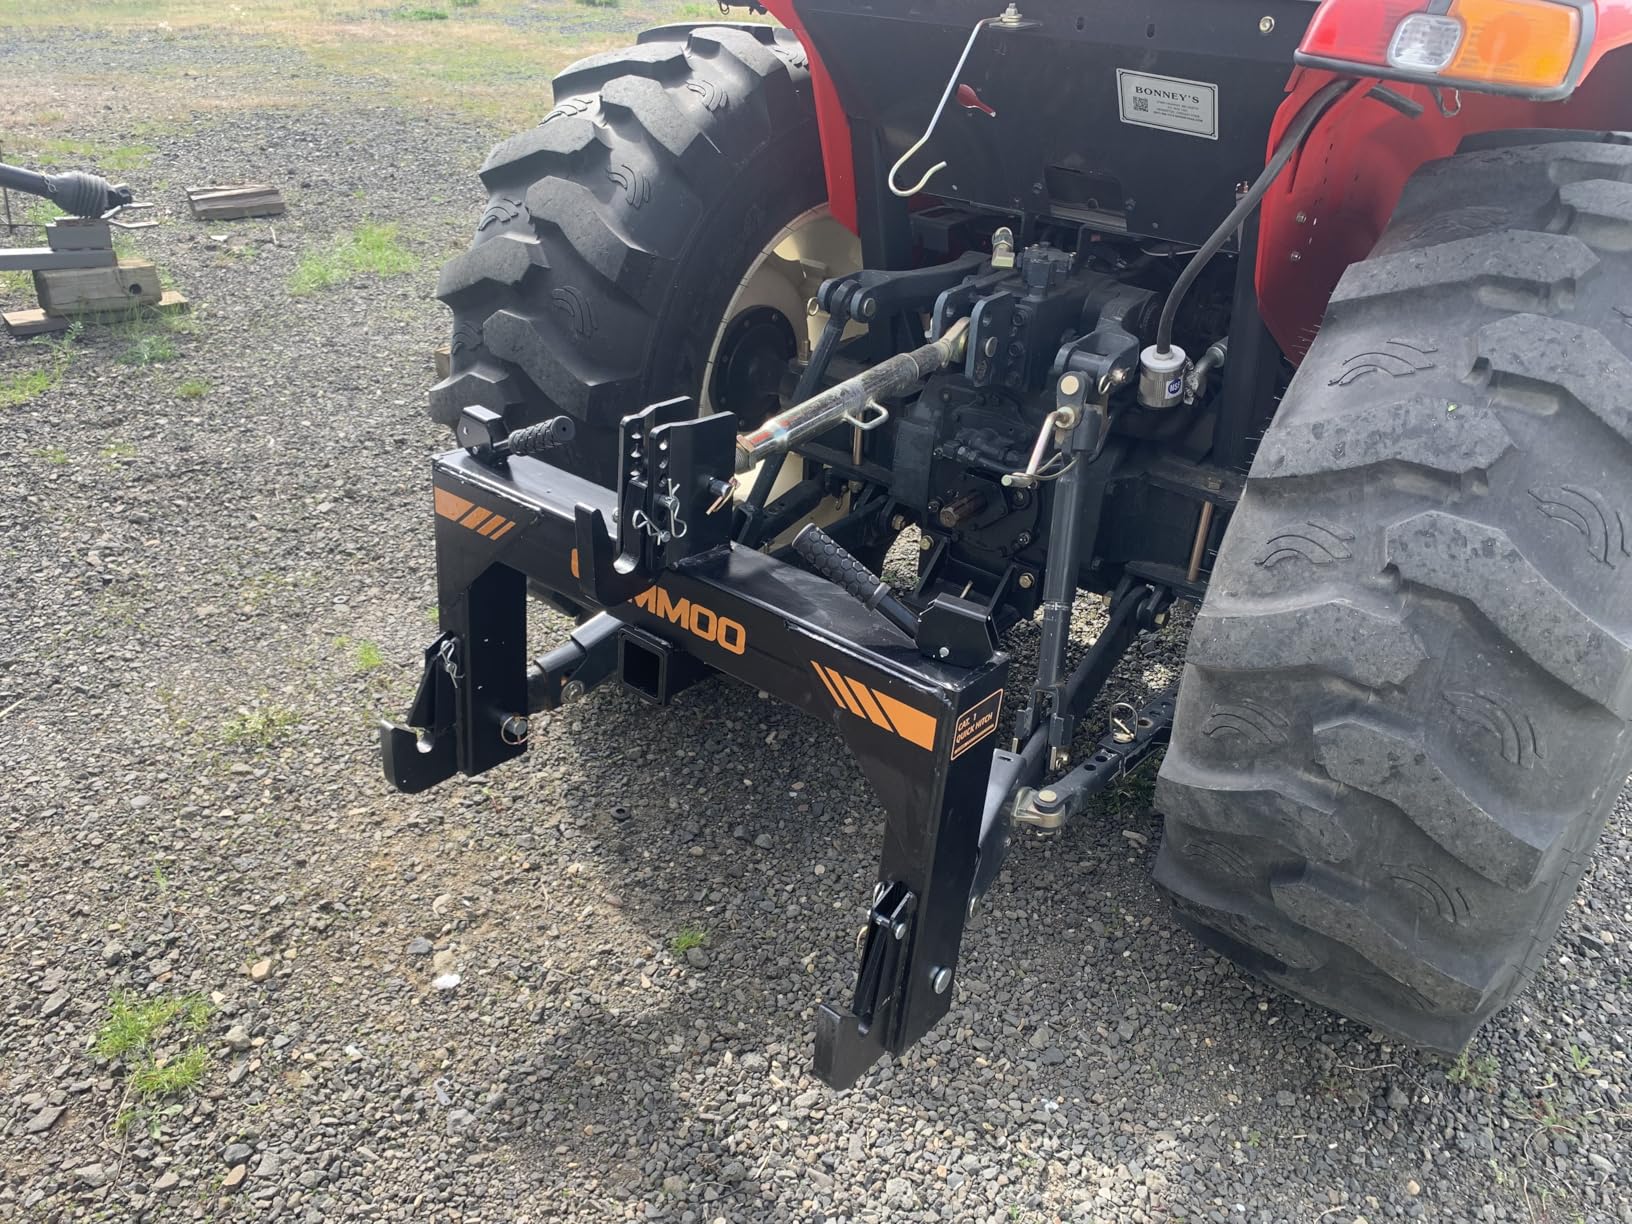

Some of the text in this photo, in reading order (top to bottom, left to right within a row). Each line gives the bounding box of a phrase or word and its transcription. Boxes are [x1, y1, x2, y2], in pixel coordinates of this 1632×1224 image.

[1135, 86, 1200, 104] BONNEY'S
[1169, 380, 1181, 392] NSF
[956, 712, 993, 743] QUICK HITCH
